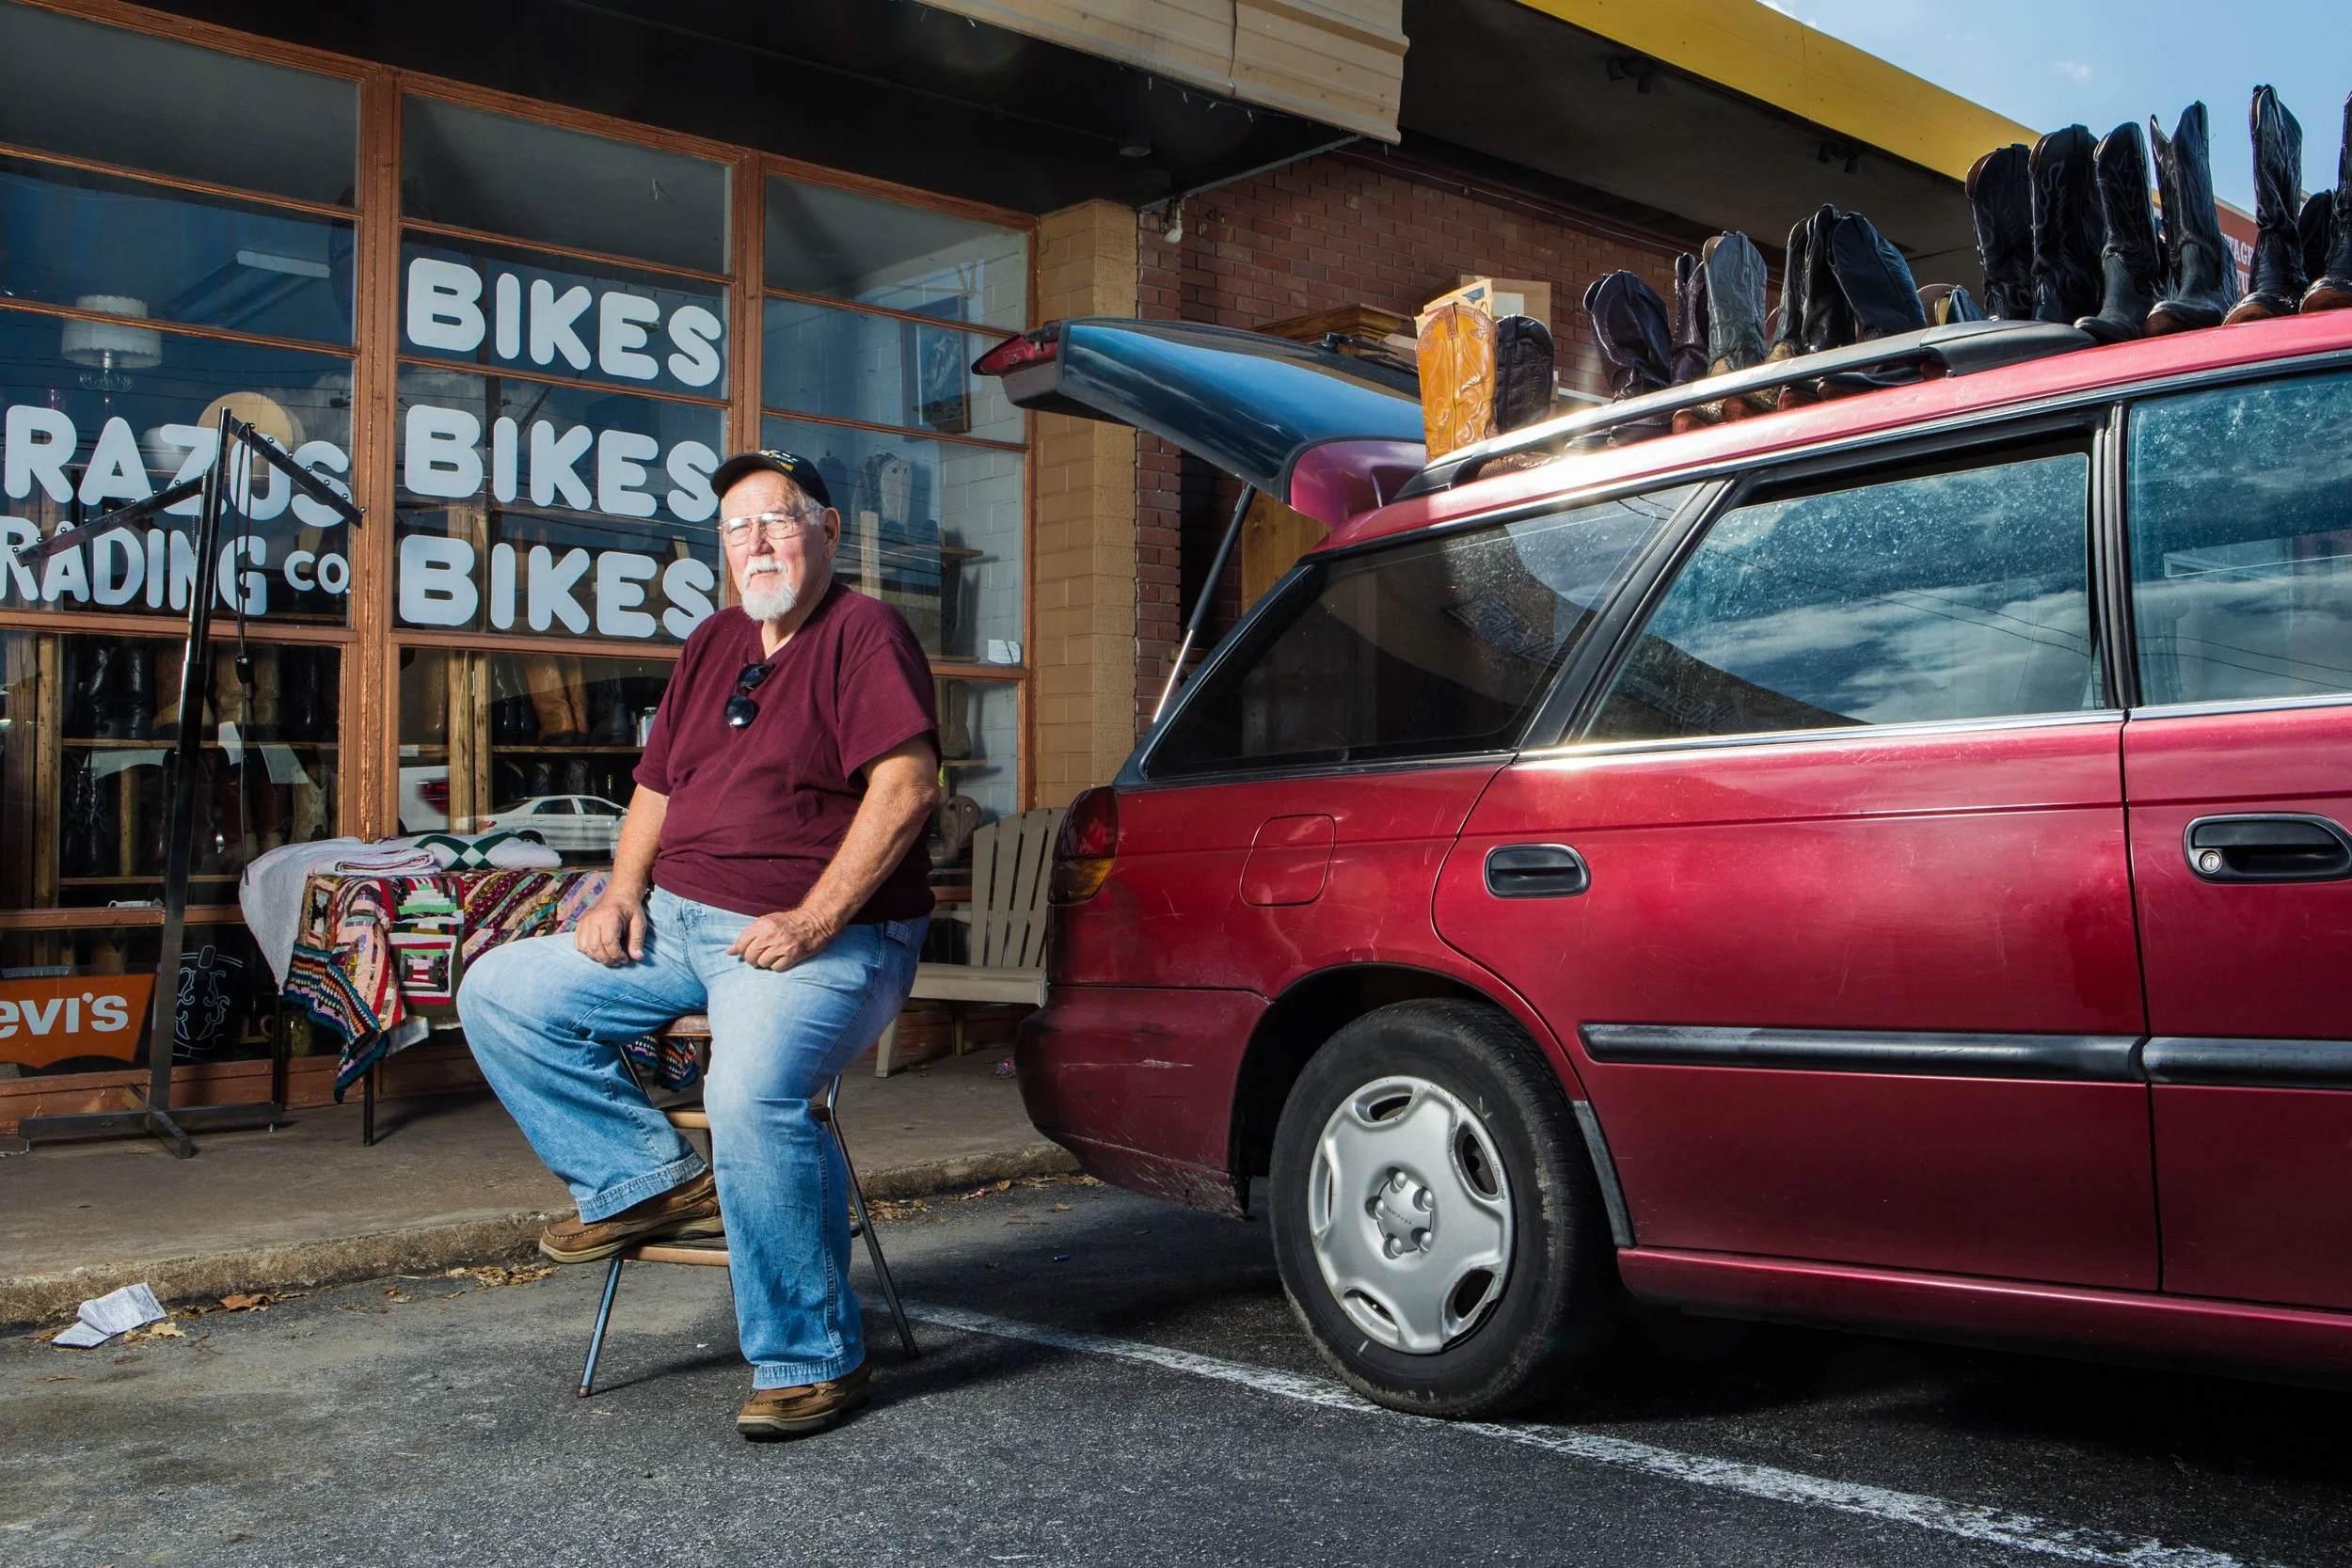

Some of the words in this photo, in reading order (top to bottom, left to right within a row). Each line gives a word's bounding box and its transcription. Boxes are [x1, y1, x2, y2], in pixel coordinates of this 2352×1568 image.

[2221, 232, 2255, 266] TAG
[406, 257, 722, 388] BIKES
[4, 404, 353, 528] RAZOS
[405, 404, 720, 523] BIKES
[399, 533, 716, 641] BIKES
